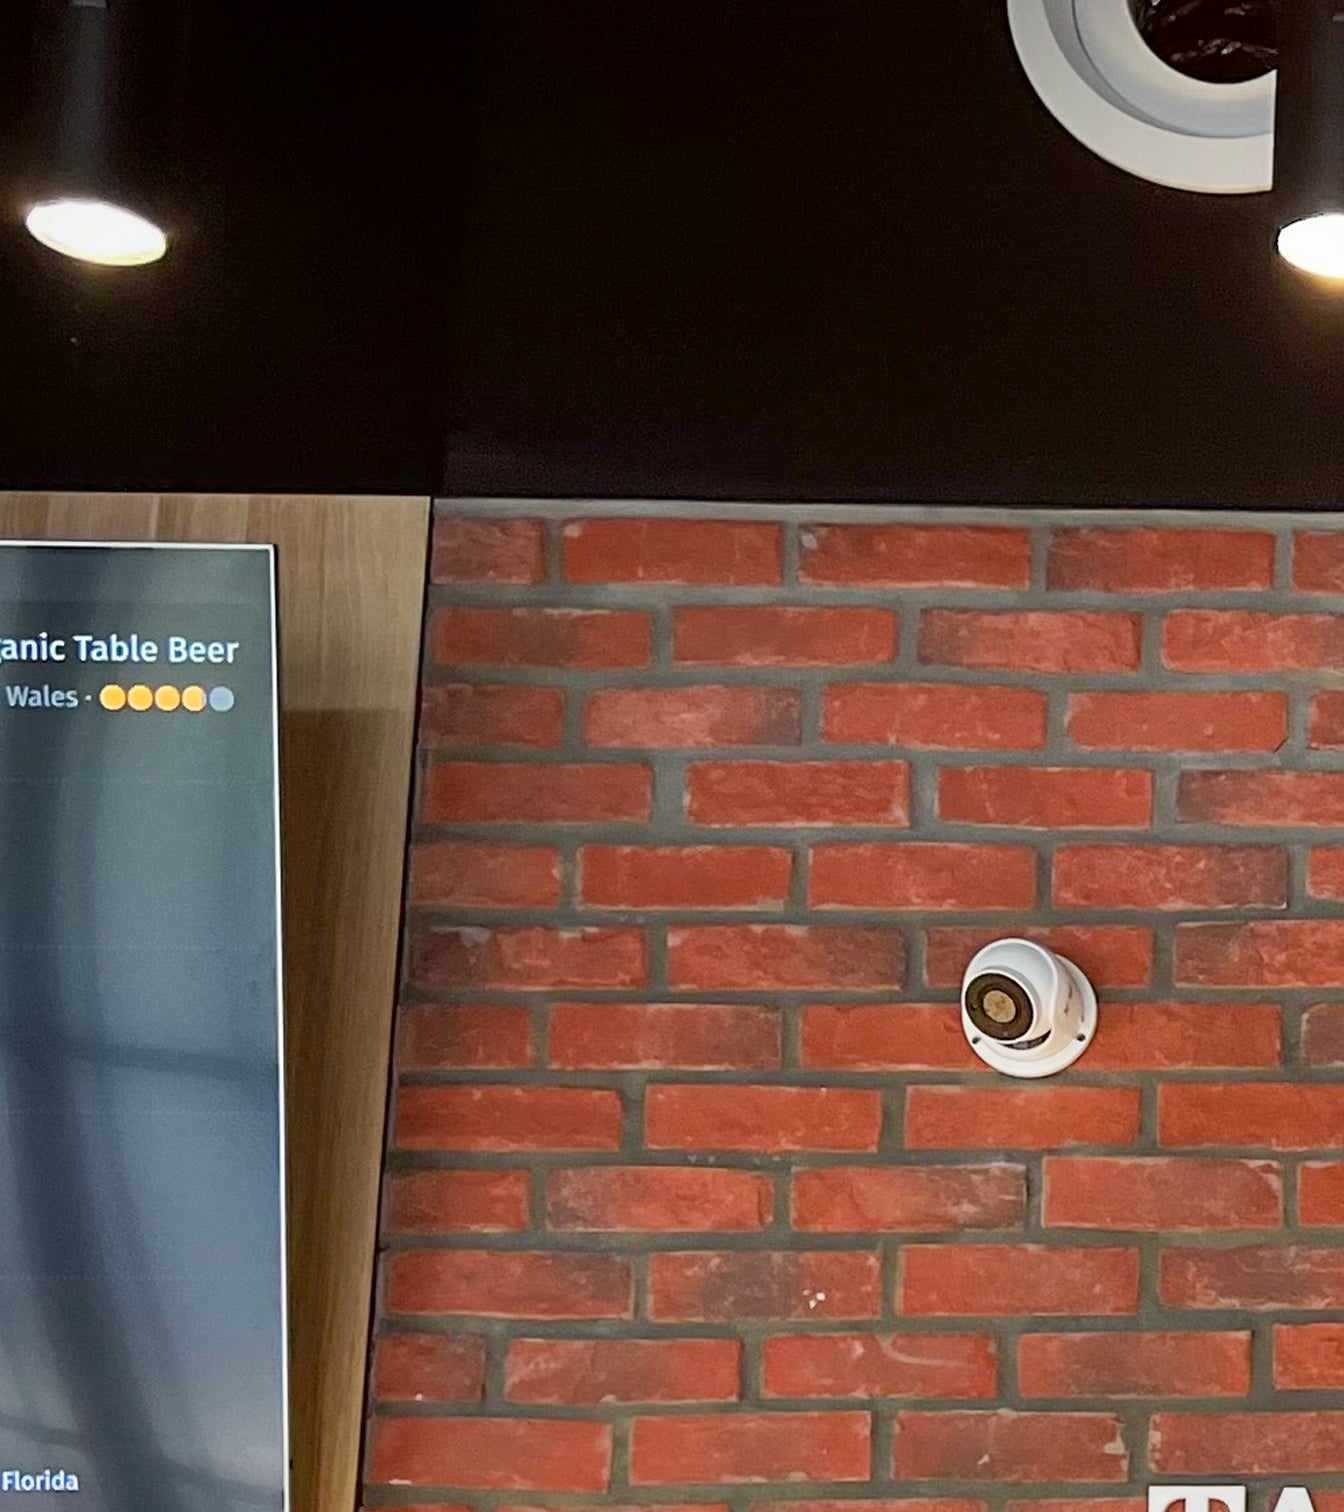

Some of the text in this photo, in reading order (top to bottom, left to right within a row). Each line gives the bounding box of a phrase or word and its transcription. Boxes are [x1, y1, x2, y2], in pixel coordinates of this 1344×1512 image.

[0, 632, 240, 664] anic Table Beer
[6, 684, 79, 708] Wales
[2, 1469, 79, 1492] Florida
